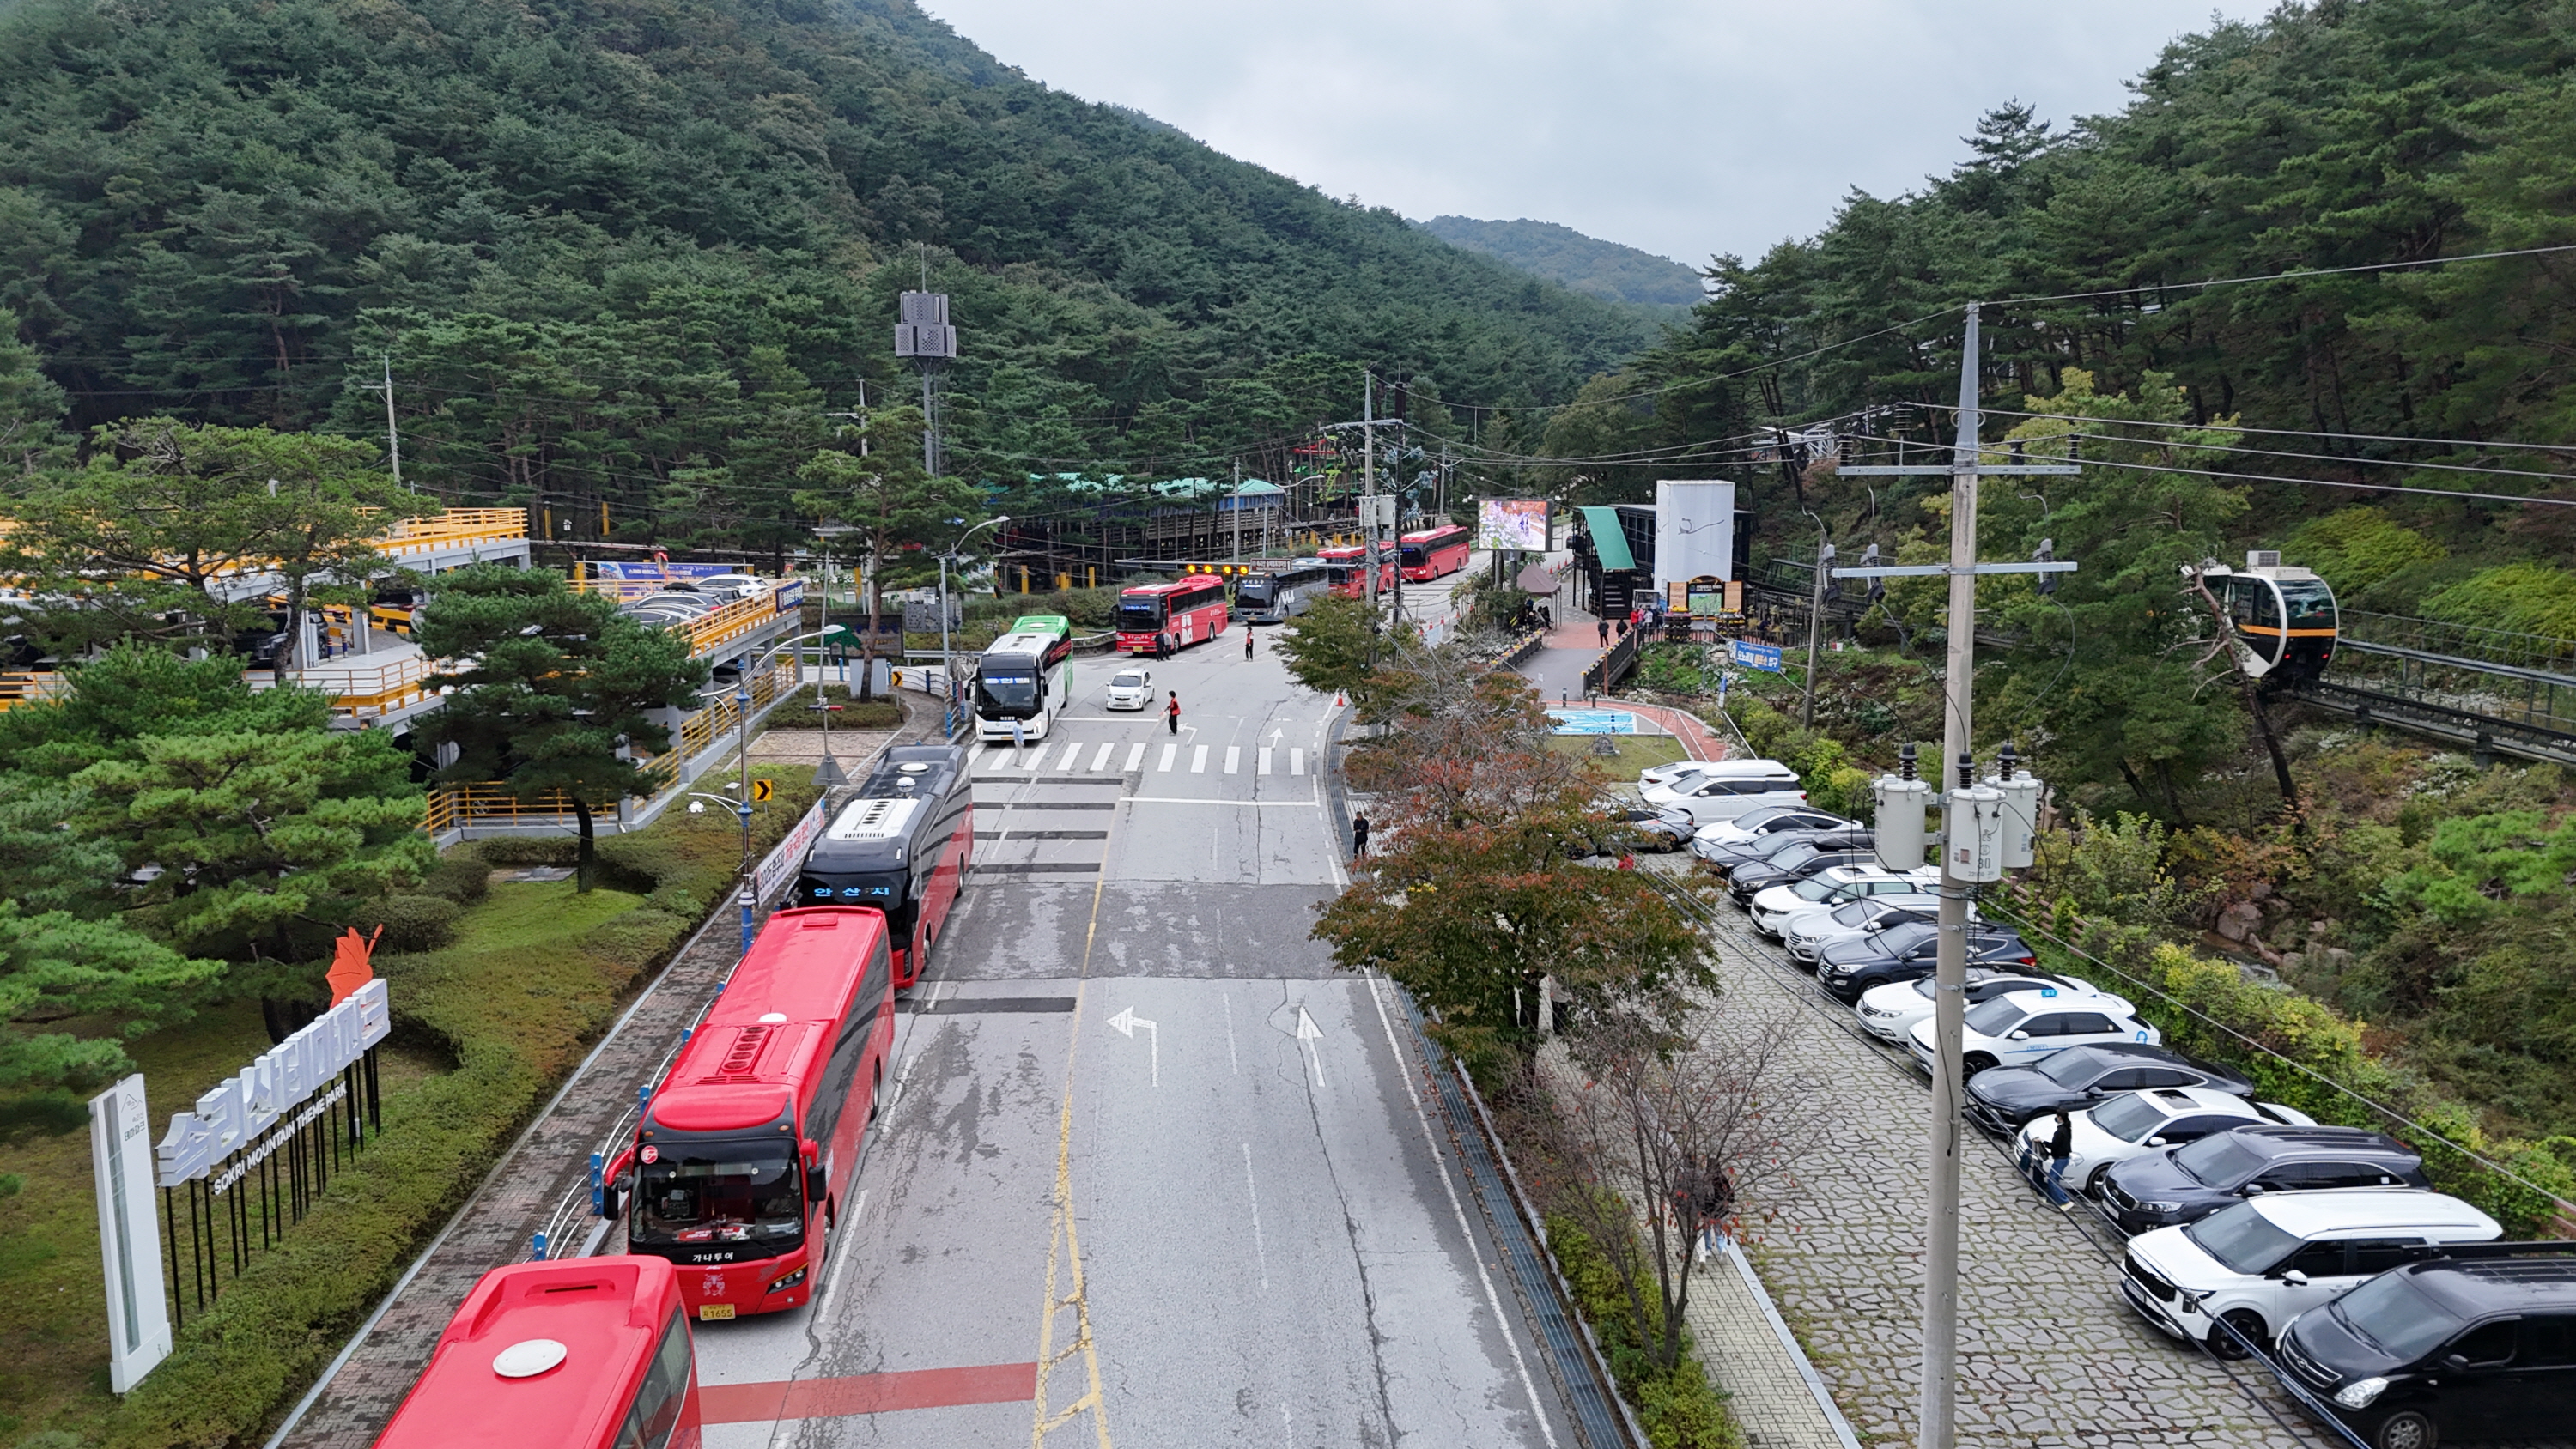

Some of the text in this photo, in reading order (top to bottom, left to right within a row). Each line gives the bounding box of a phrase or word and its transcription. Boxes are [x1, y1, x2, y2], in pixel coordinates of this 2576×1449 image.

[124, 1120, 146, 1142] 테마파크
[214, 1080, 348, 1196] SOKRI MOUNTAIN THEME PARK
[692, 1252, 734, 1263] 가나투어
